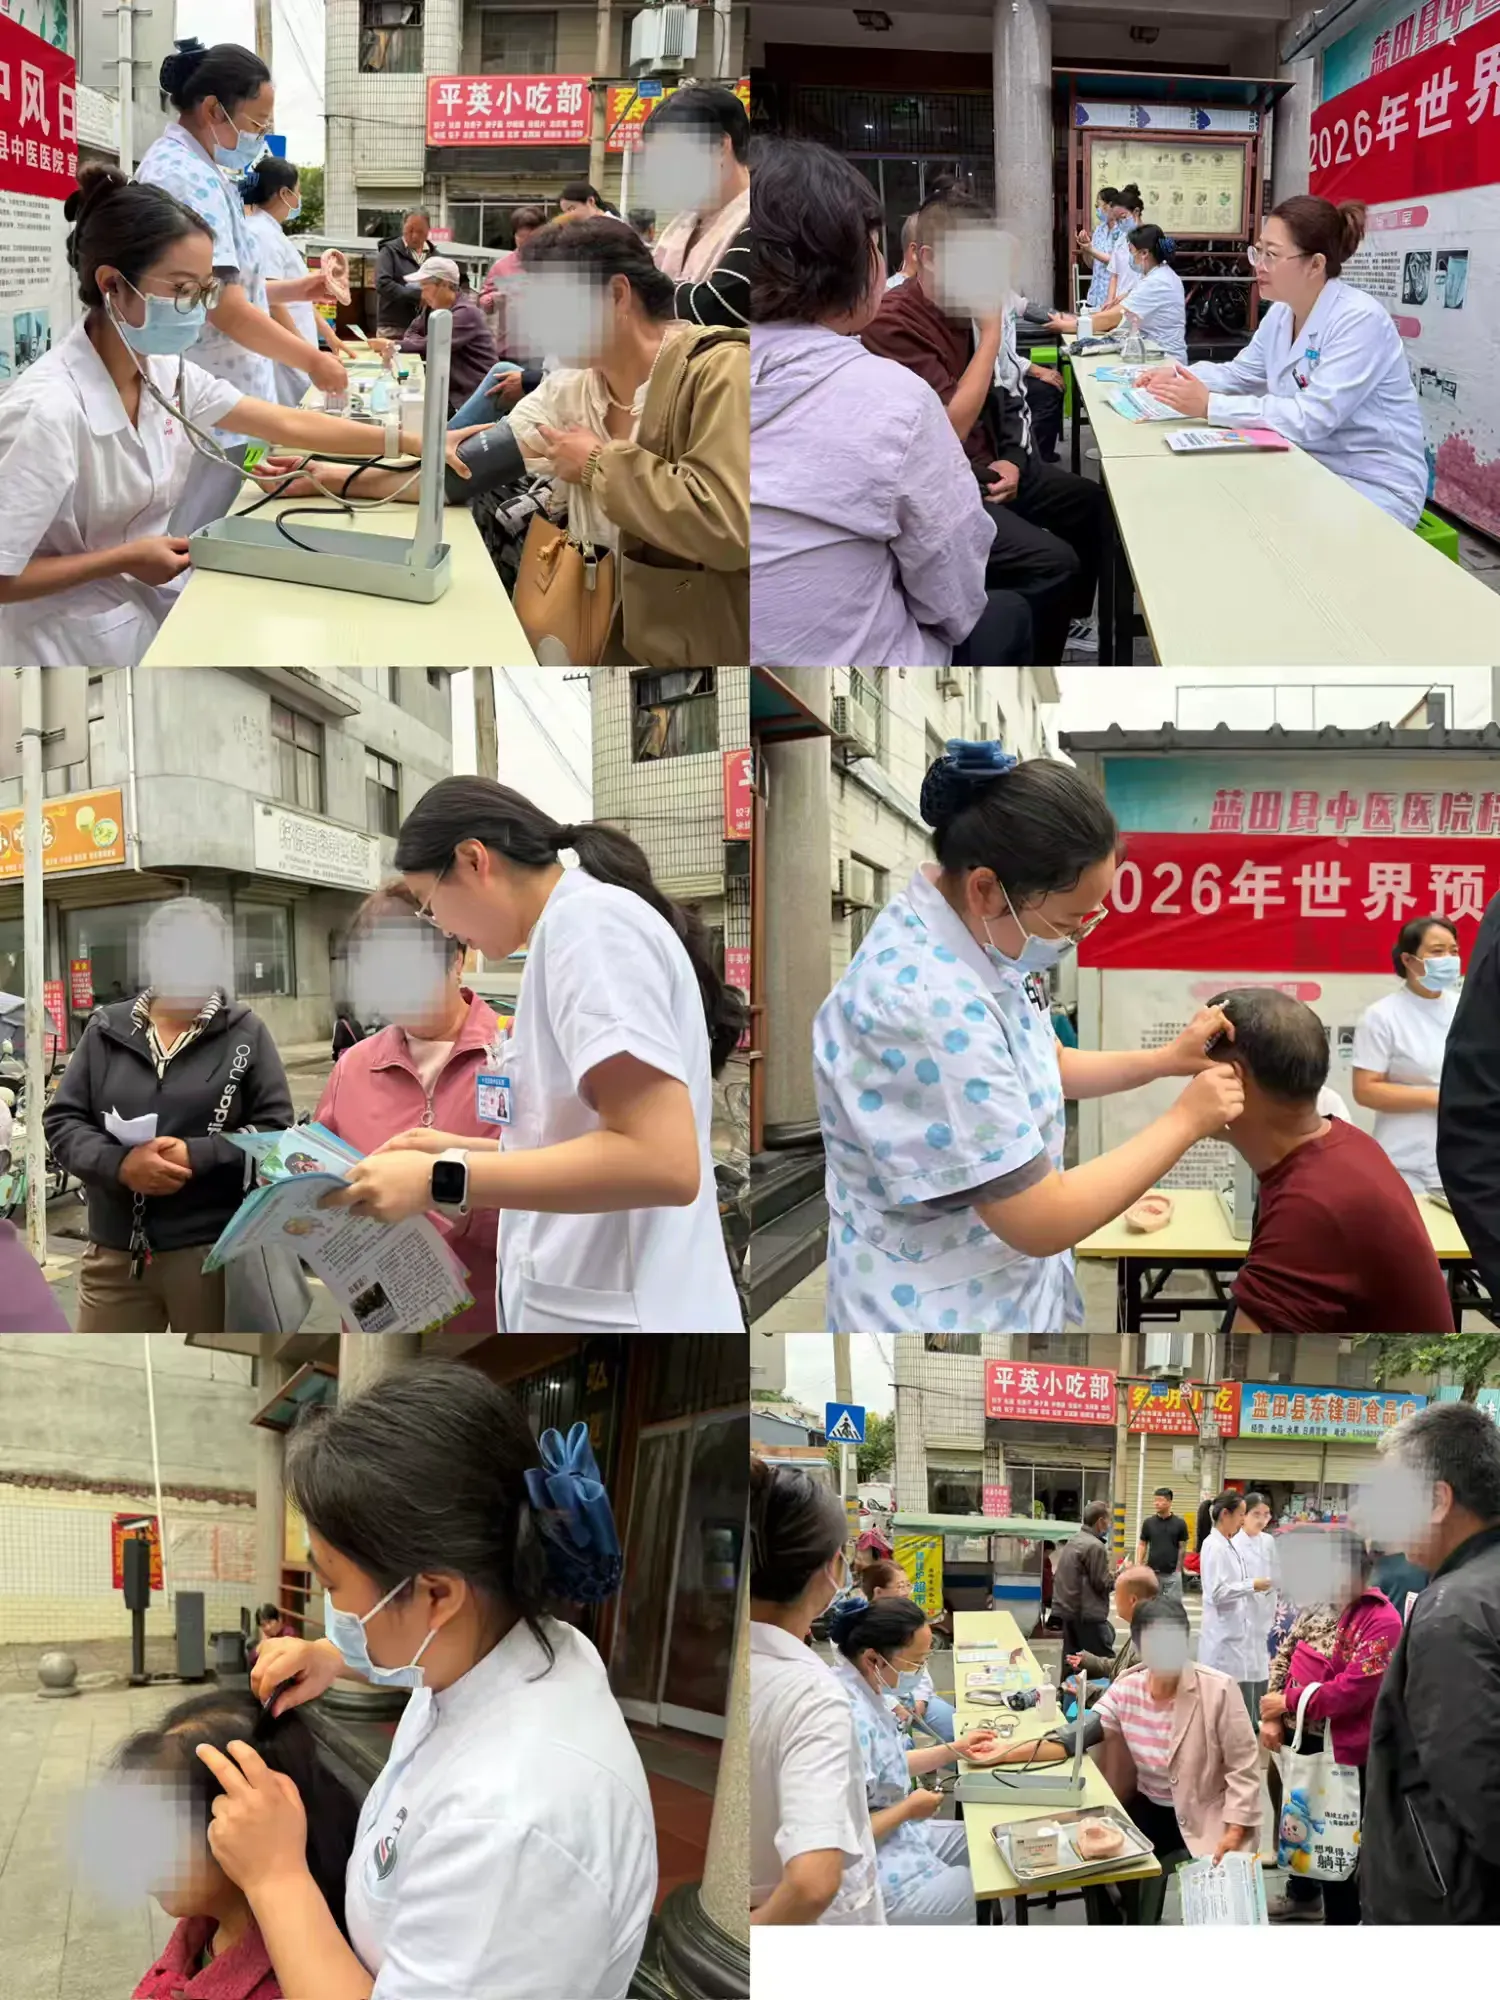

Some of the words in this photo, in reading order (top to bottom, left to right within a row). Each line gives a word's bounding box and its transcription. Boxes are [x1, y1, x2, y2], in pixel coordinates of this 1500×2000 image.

[437, 82, 583, 116] 平英小吃部
[229, 1044, 250, 1081] neo
[994, 1367, 1110, 1401] 平英小吃部
